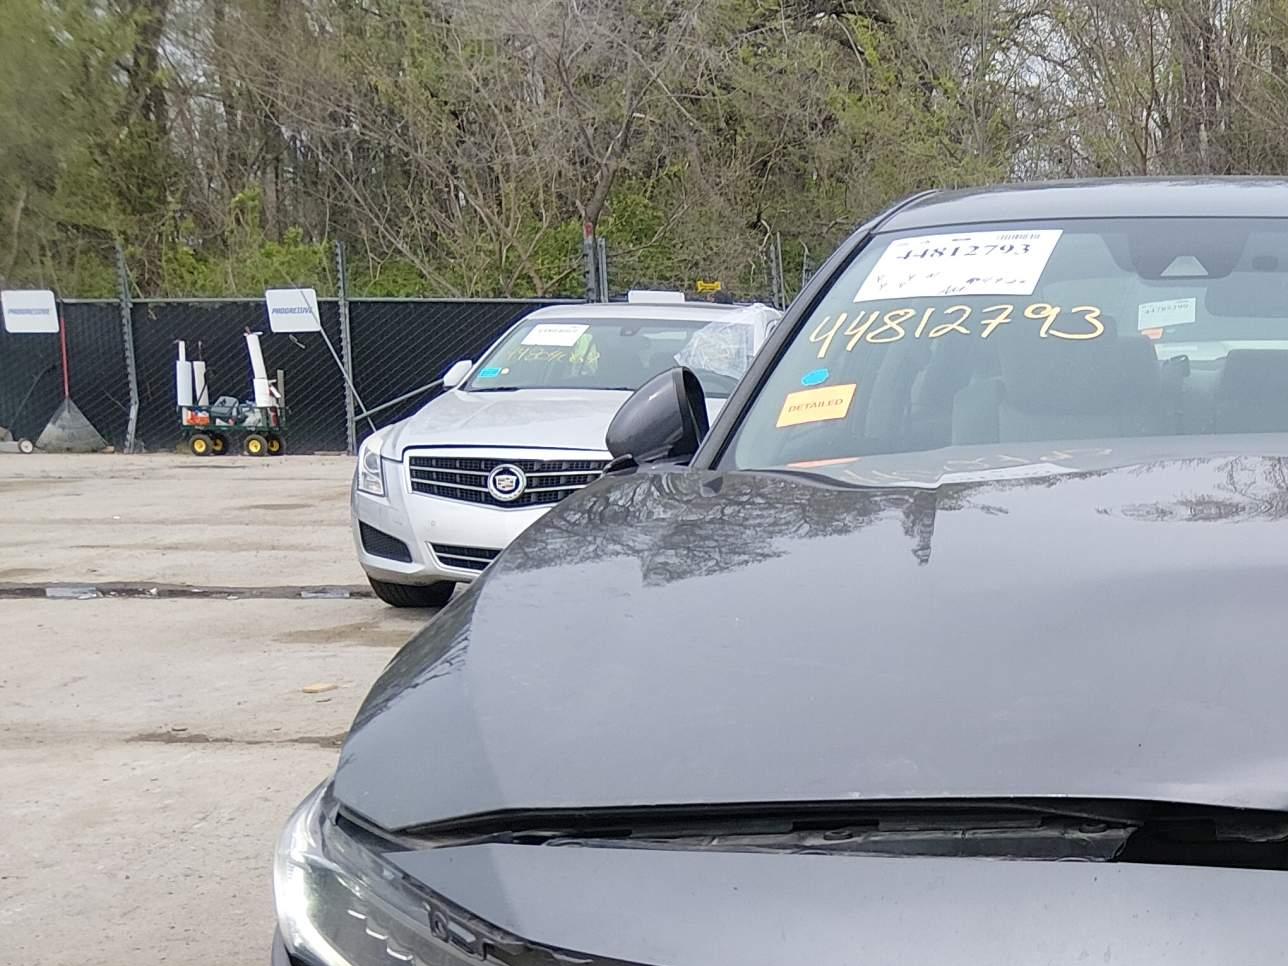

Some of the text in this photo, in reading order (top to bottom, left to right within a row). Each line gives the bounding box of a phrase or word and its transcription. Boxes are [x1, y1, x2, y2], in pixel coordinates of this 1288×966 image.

[896, 243, 1032, 261] 44812793
[809, 303, 1104, 358] 44812793
[787, 398, 845, 414] DETAILED
